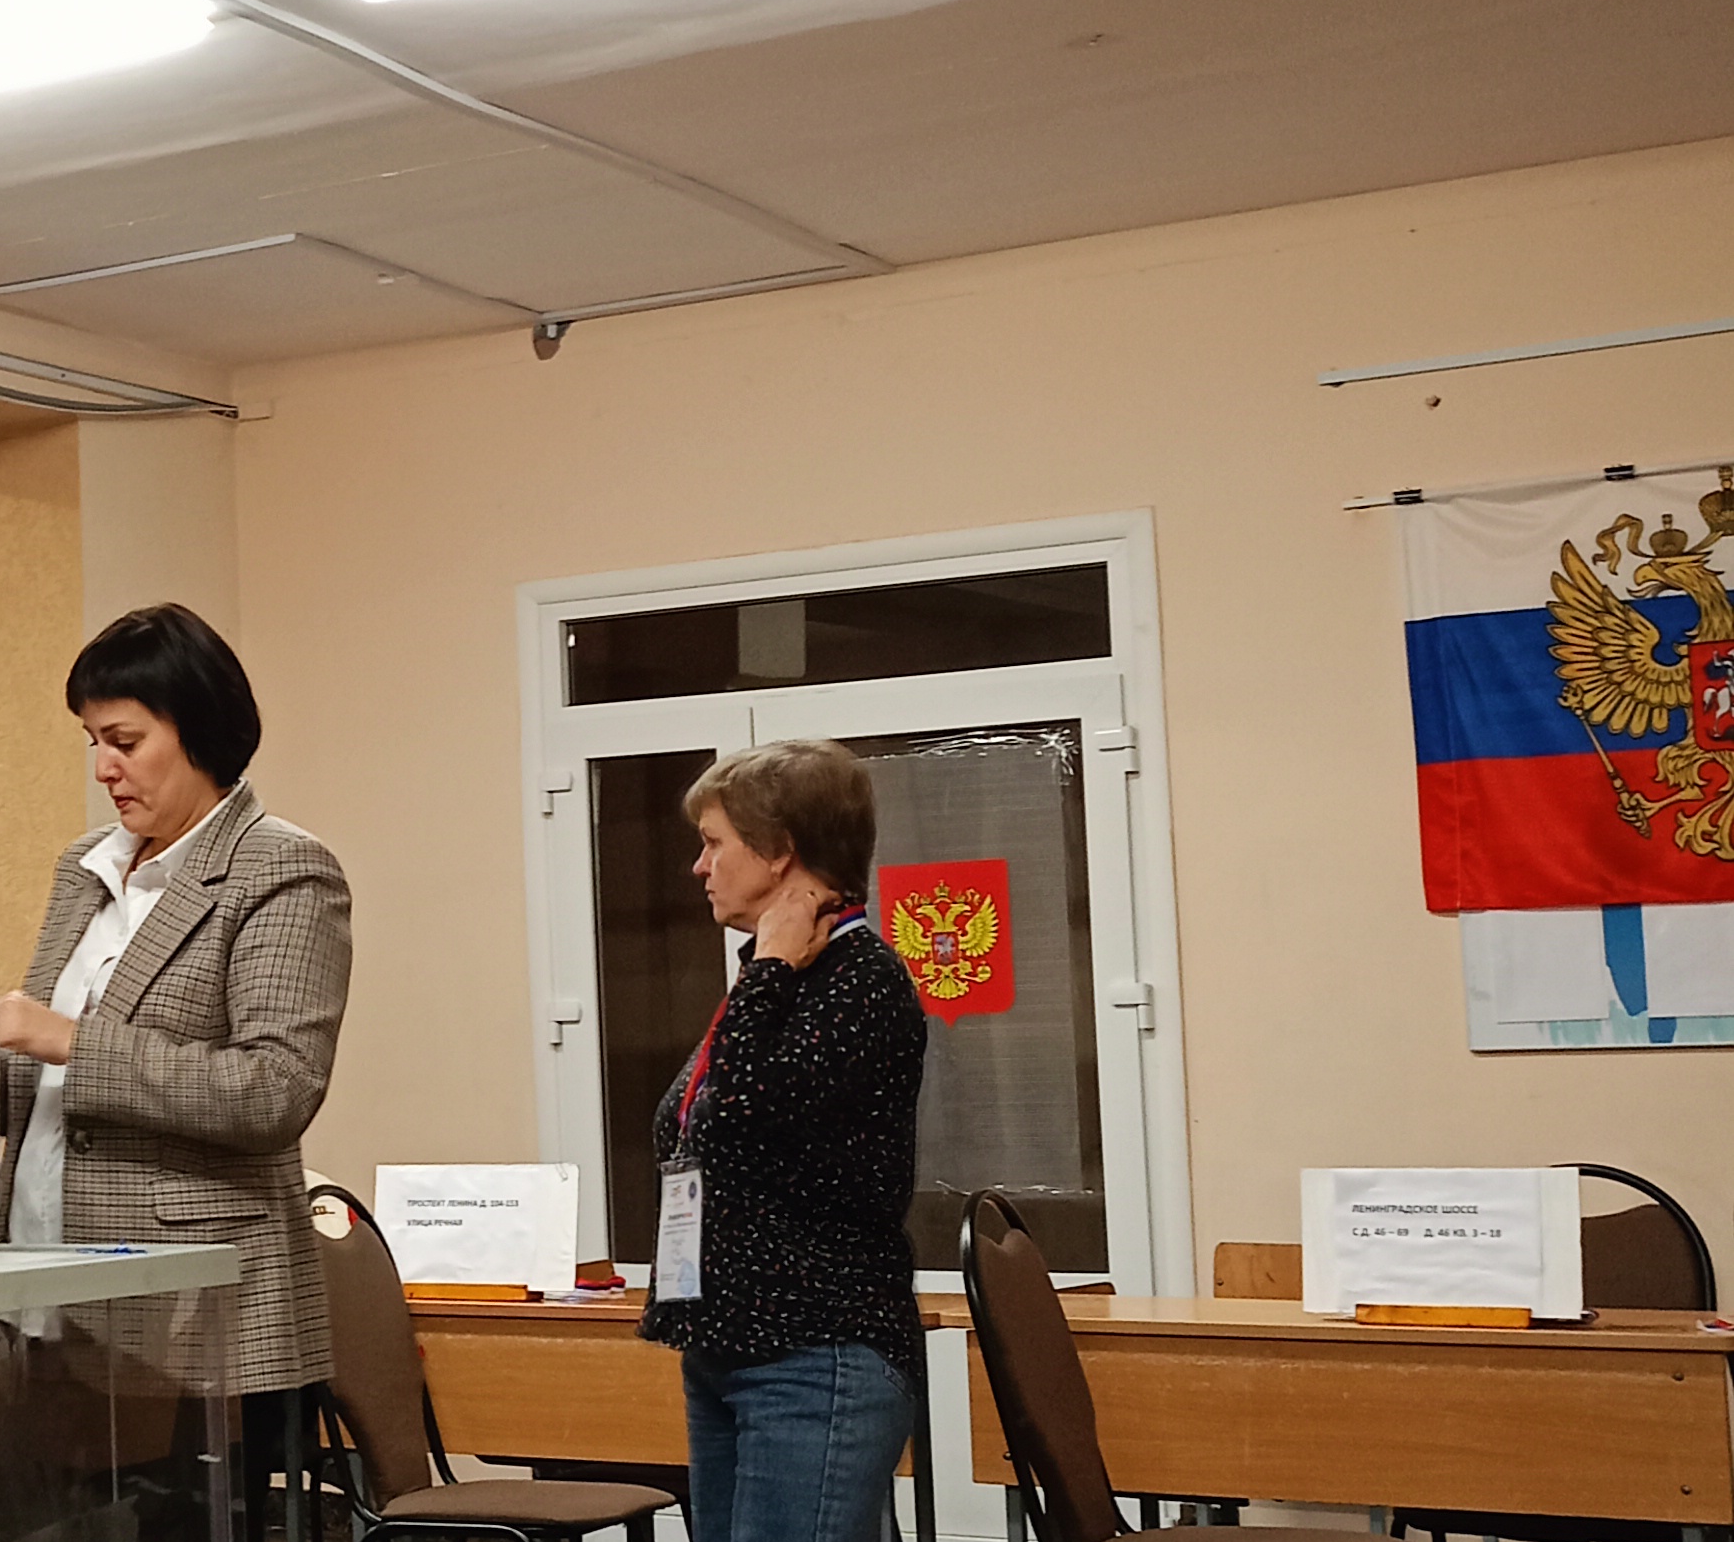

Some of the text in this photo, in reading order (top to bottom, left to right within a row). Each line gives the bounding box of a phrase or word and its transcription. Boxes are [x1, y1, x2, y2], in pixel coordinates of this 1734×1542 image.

[407, 1199, 446, 1207] ПРОСПЕКТ
[447, 1199, 478, 1207] ЛЕНИНА
[1351, 1204, 1479, 1215] ЛЕНИНГРАДСКОЕ ШОССЕ
